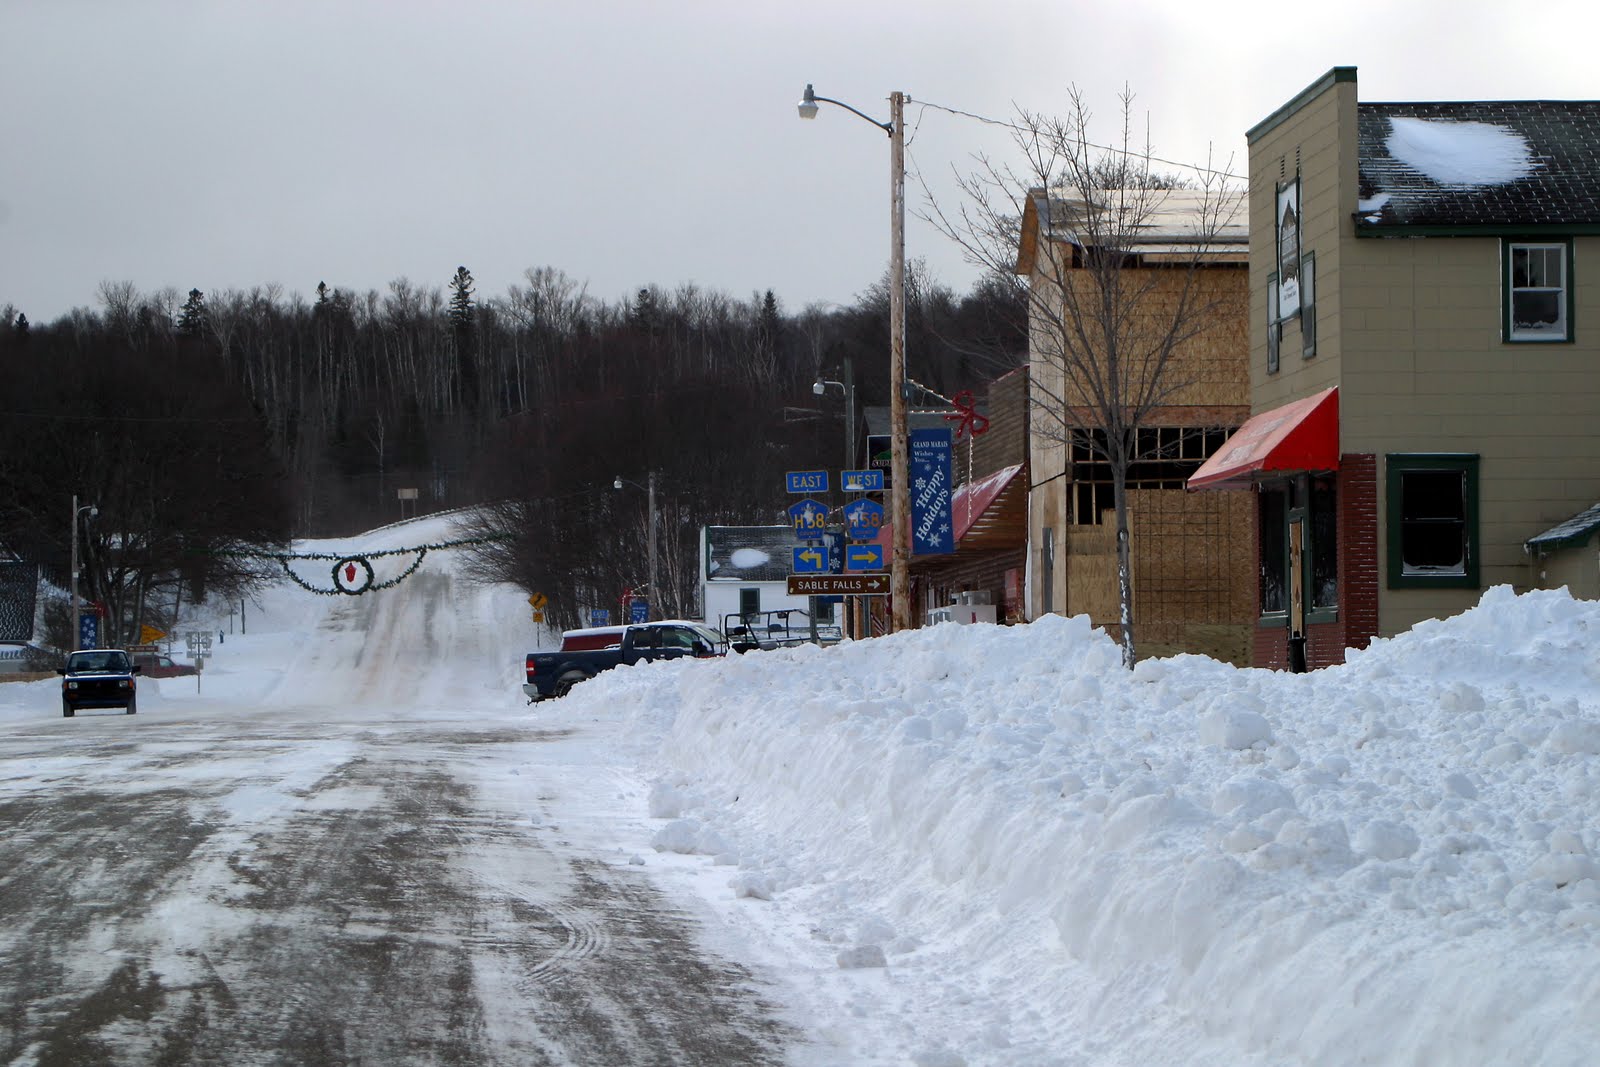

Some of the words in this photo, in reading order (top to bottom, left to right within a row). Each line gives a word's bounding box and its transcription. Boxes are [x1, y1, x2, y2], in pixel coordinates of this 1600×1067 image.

[930, 440, 948, 448] MARAIS
[793, 475, 822, 488] EAST
[847, 474, 878, 487] WEST
[915, 465, 945, 509] Happy
[915, 488, 949, 541] Holidays
[798, 581, 829, 590] SABLE
[833, 580, 862, 589] FALLS
